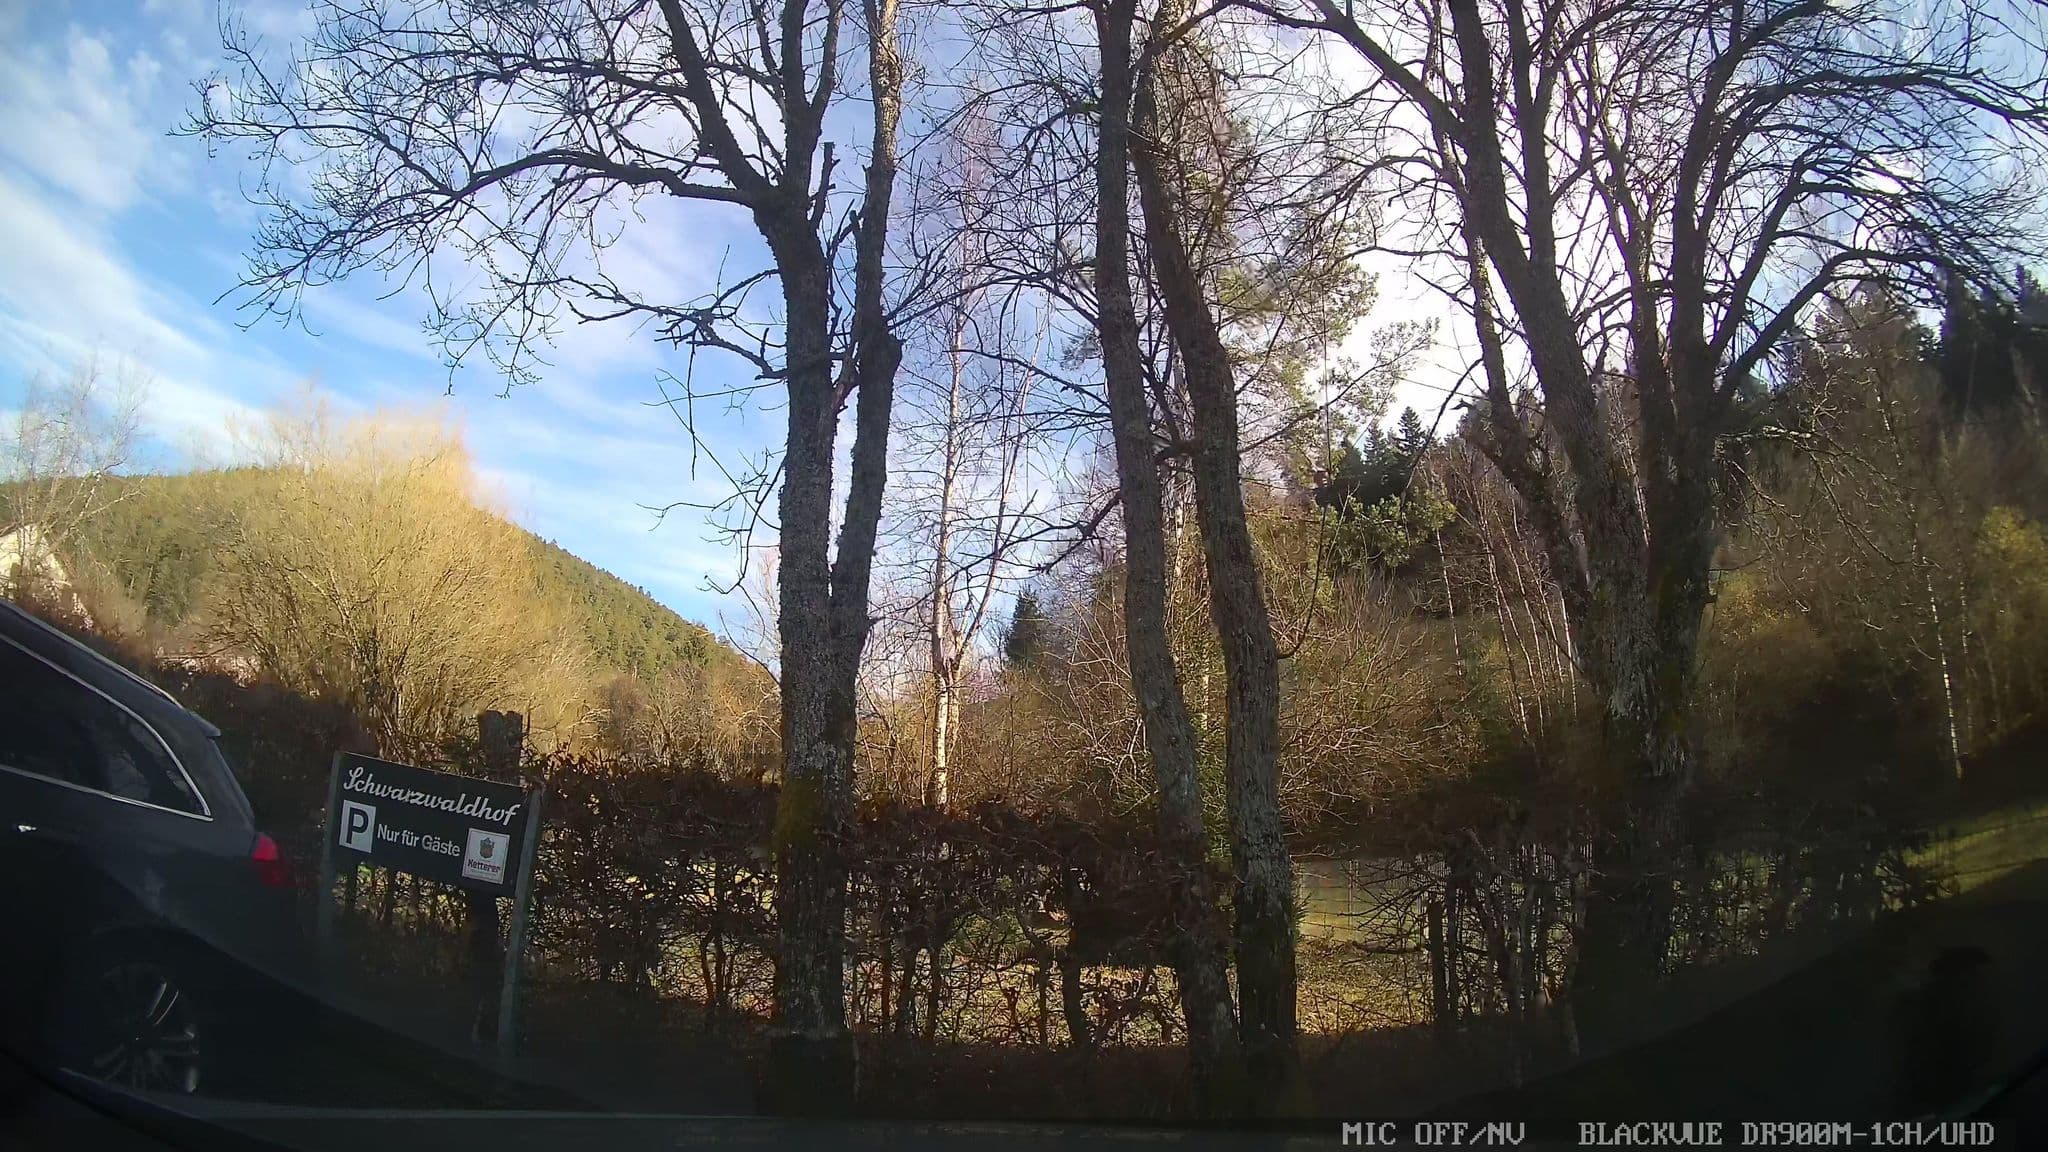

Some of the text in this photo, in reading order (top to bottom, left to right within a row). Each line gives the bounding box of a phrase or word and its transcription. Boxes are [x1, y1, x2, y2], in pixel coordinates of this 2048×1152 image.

[343, 766, 521, 826] Schwarzwaldhof
[345, 806, 369, 845] P
[377, 823, 461, 857] Nur für Gäste
[467, 858, 501, 873] Ketterer
